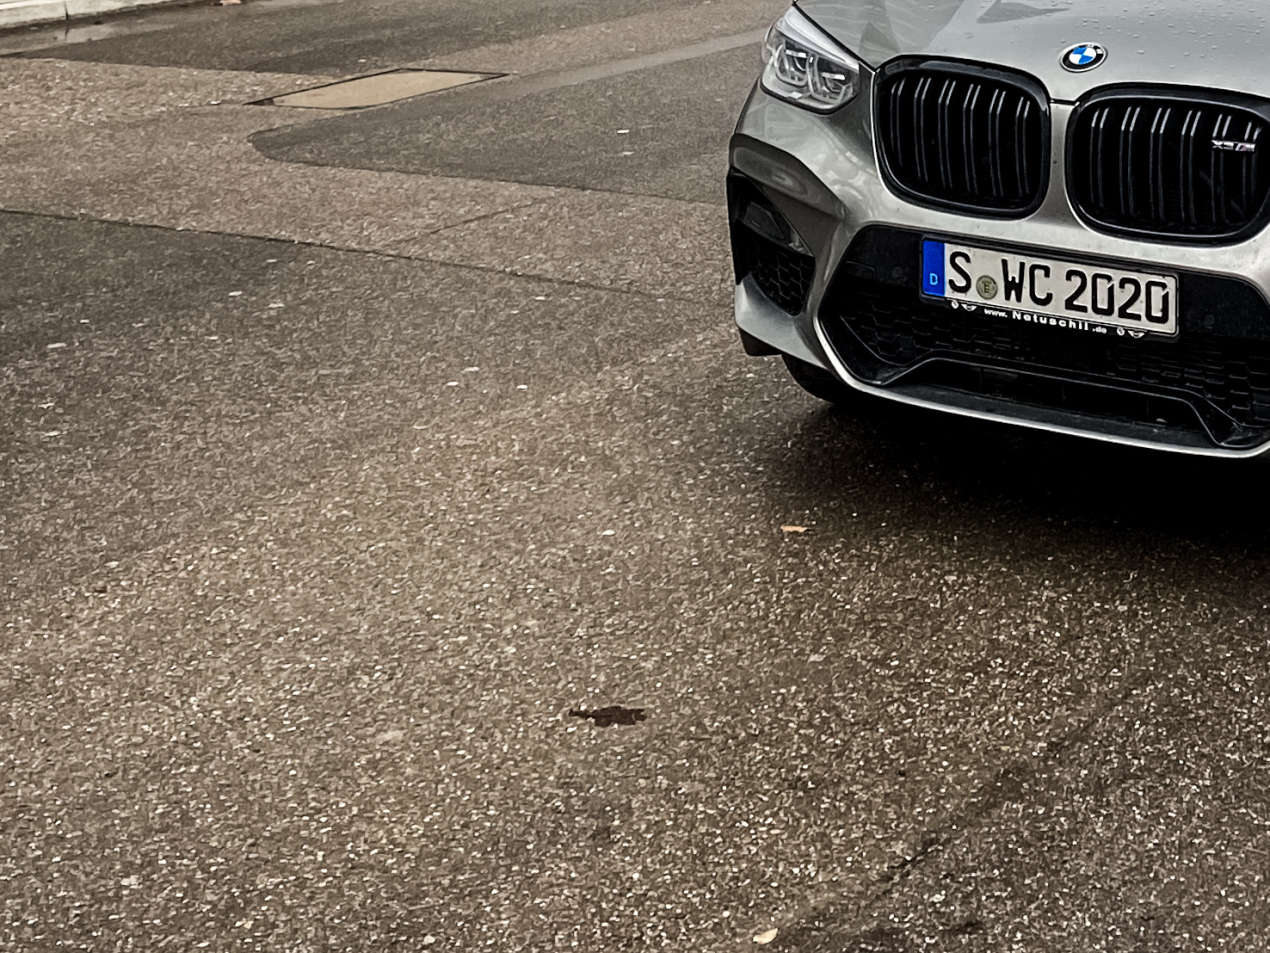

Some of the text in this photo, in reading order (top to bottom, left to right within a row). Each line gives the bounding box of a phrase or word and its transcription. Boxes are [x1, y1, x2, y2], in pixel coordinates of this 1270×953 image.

[929, 251, 1170, 325] D S WC 2020
